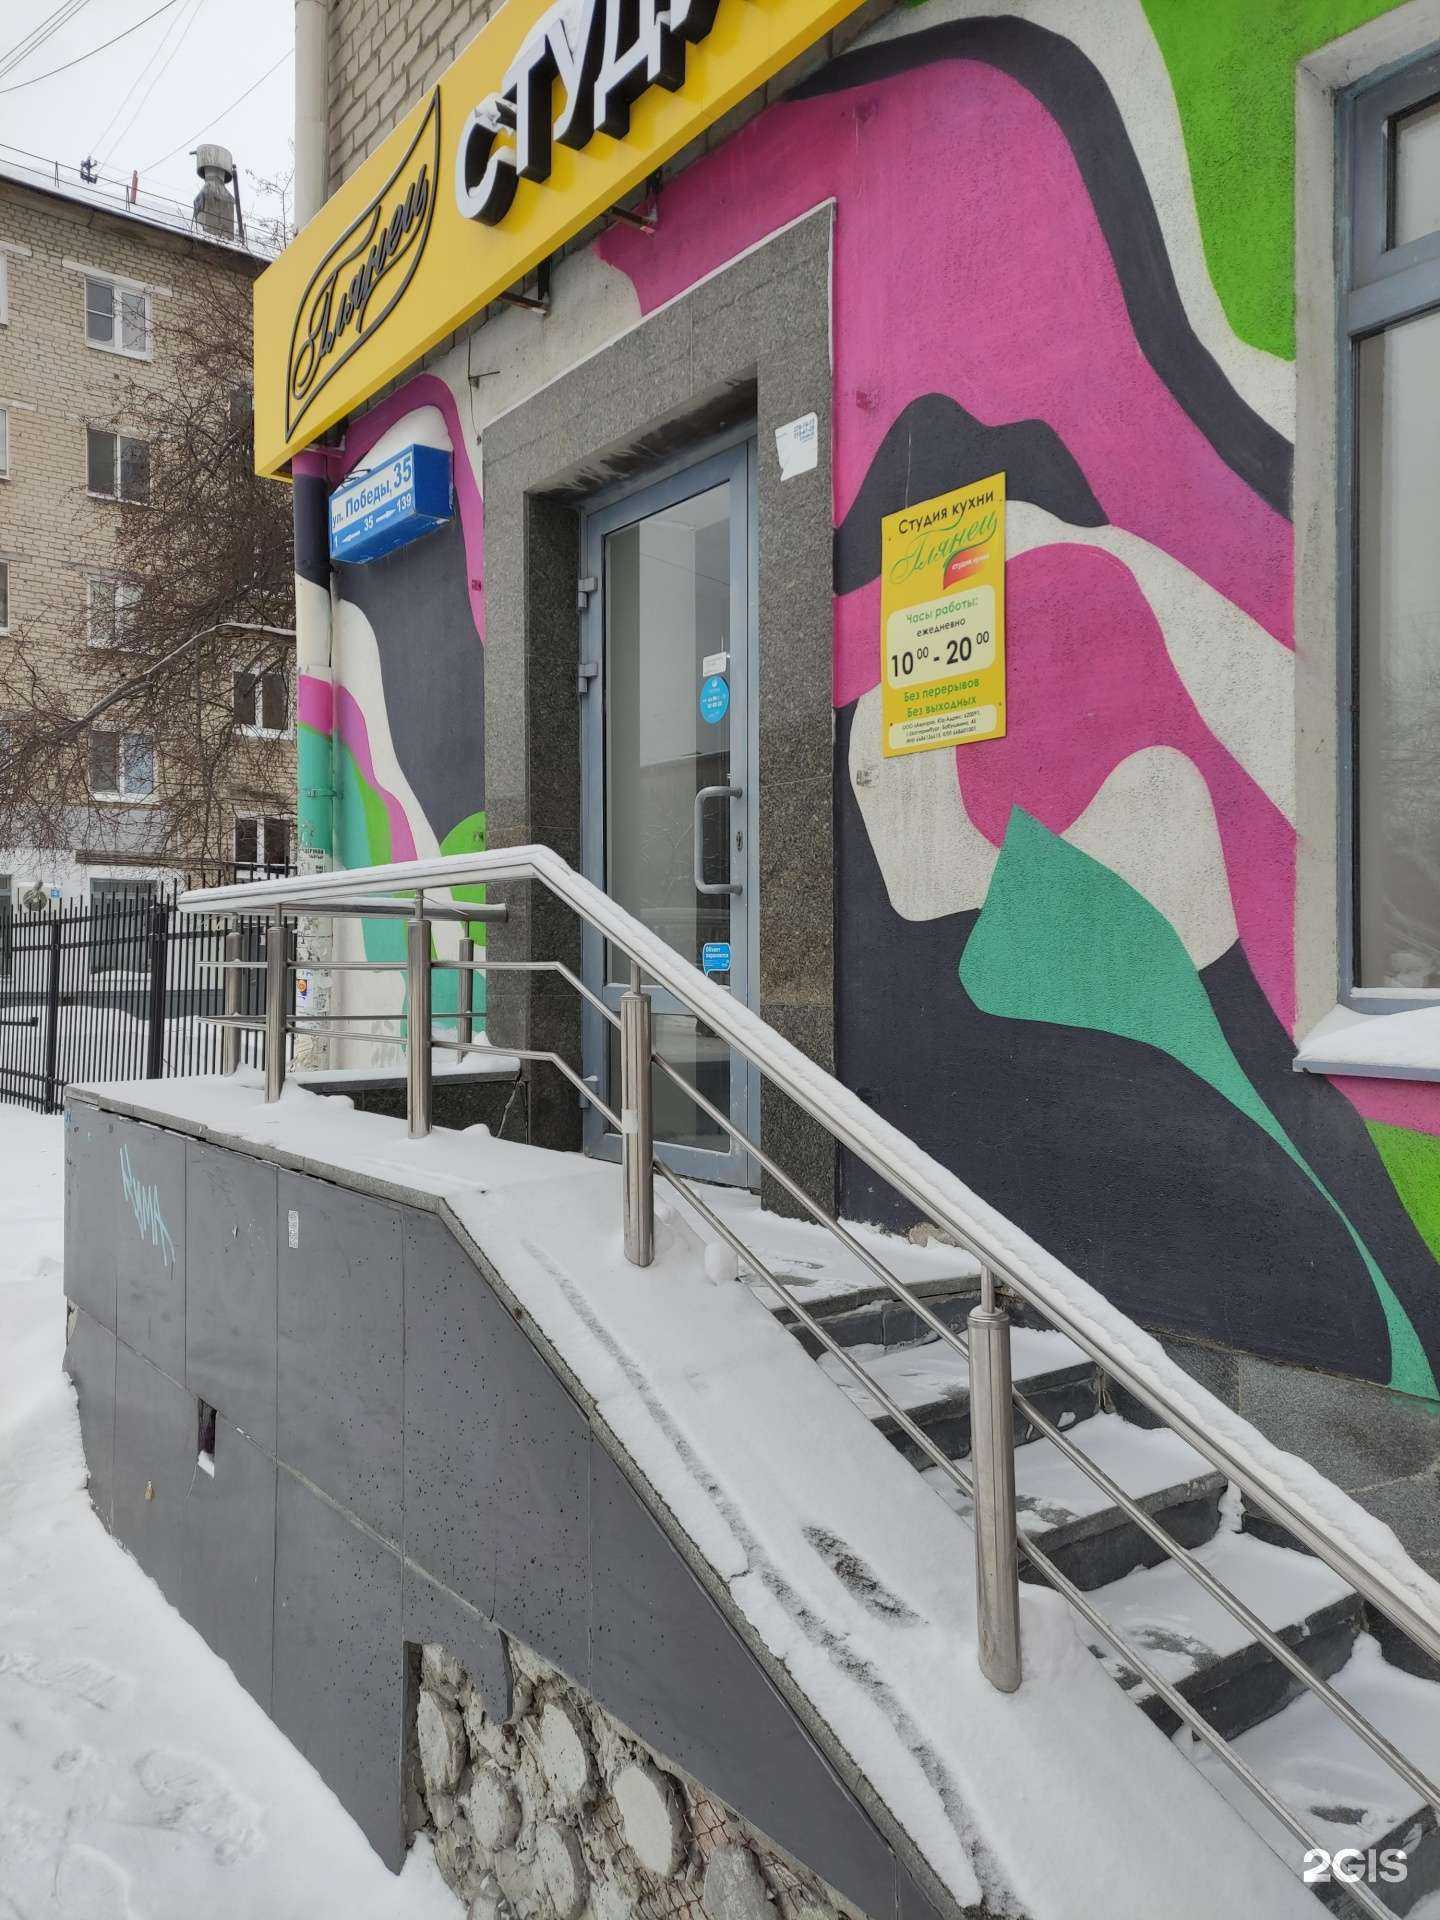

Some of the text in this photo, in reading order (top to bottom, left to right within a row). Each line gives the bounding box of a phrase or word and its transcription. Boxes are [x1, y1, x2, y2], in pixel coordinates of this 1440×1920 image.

[455, 0, 715, 225] СТУД
[332, 453, 412, 529] ул. Победы, 35
[363, 514, 374, 531] 35
[898, 490, 994, 535] Студия кухни
[906, 597, 978, 624] Часы работы:
[916, 618, 966, 637] ежедневно
[904, 678, 981, 702] Без перерывов
[907, 696, 977, 718] Без выходных
